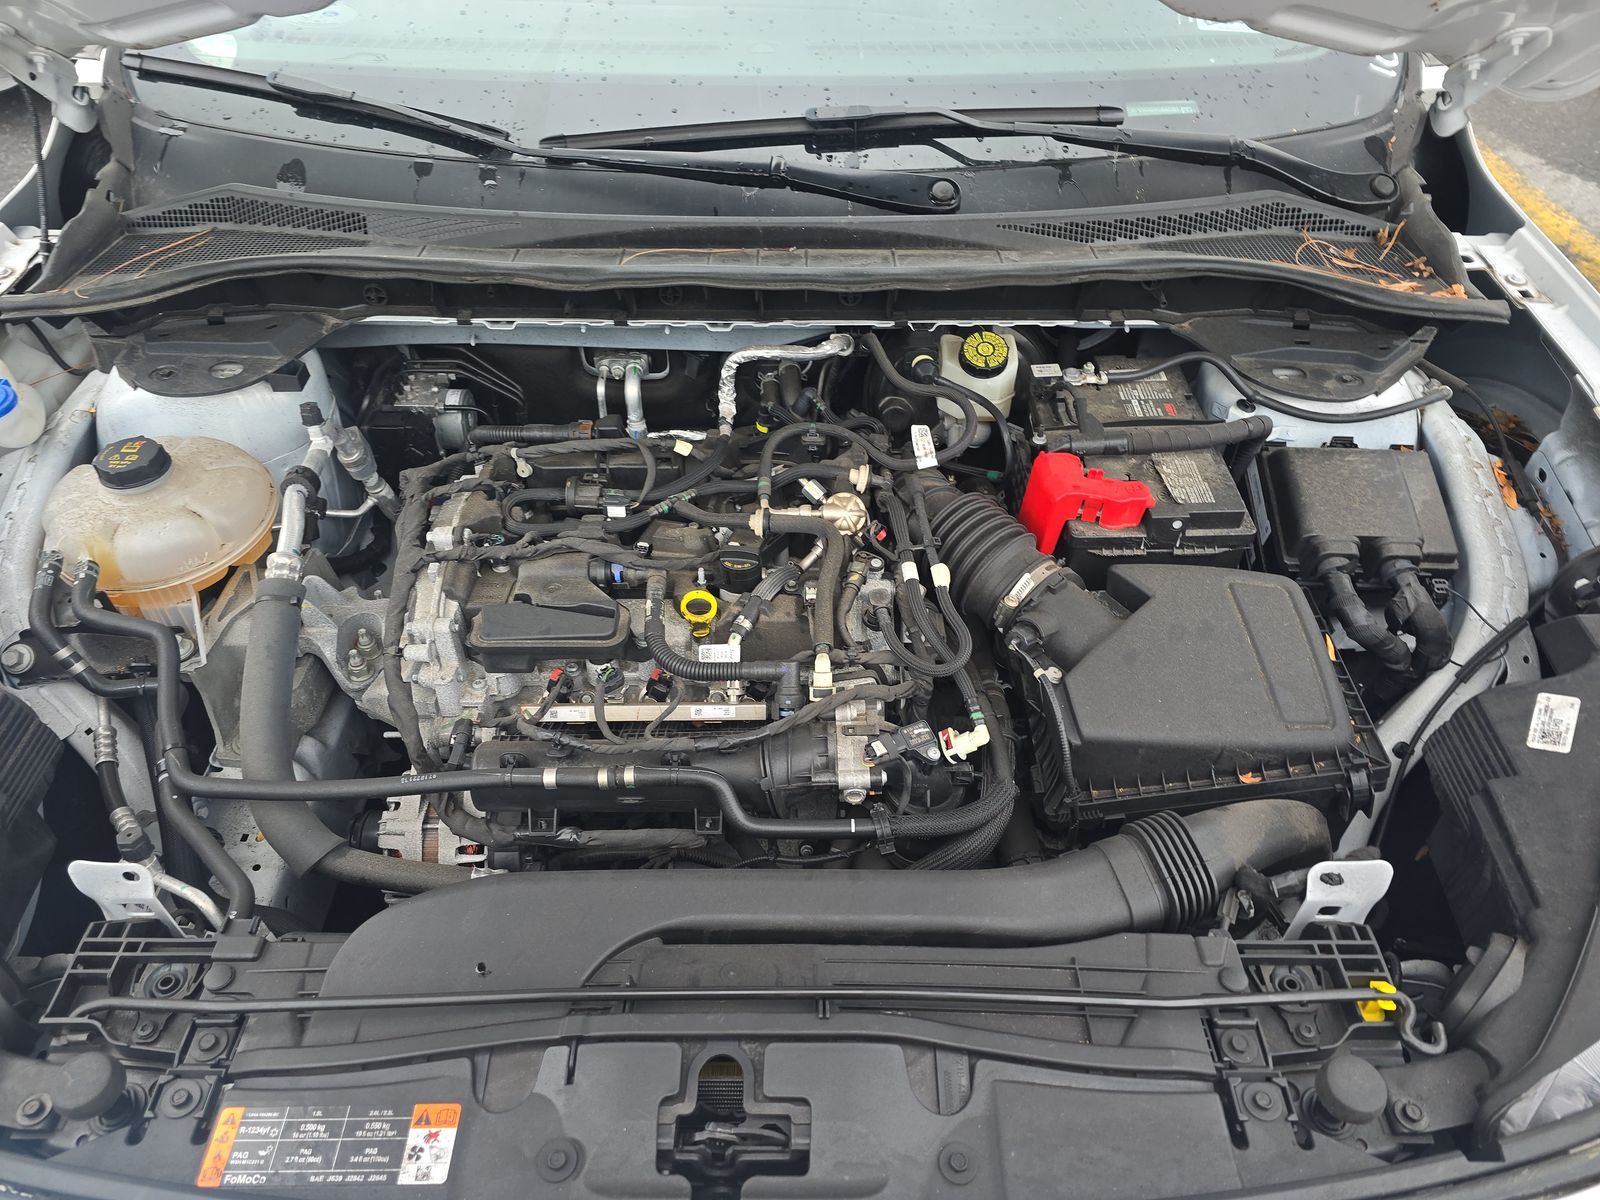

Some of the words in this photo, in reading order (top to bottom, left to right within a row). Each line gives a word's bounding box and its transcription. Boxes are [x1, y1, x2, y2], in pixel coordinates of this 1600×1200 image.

[239, 1126, 271, 1135] R-1234yf
[317, 1123, 326, 1133] kg
[382, 1122, 391, 1132] kg
[232, 1151, 249, 1159] PAG
[224, 1174, 267, 1184] FoMoCo
